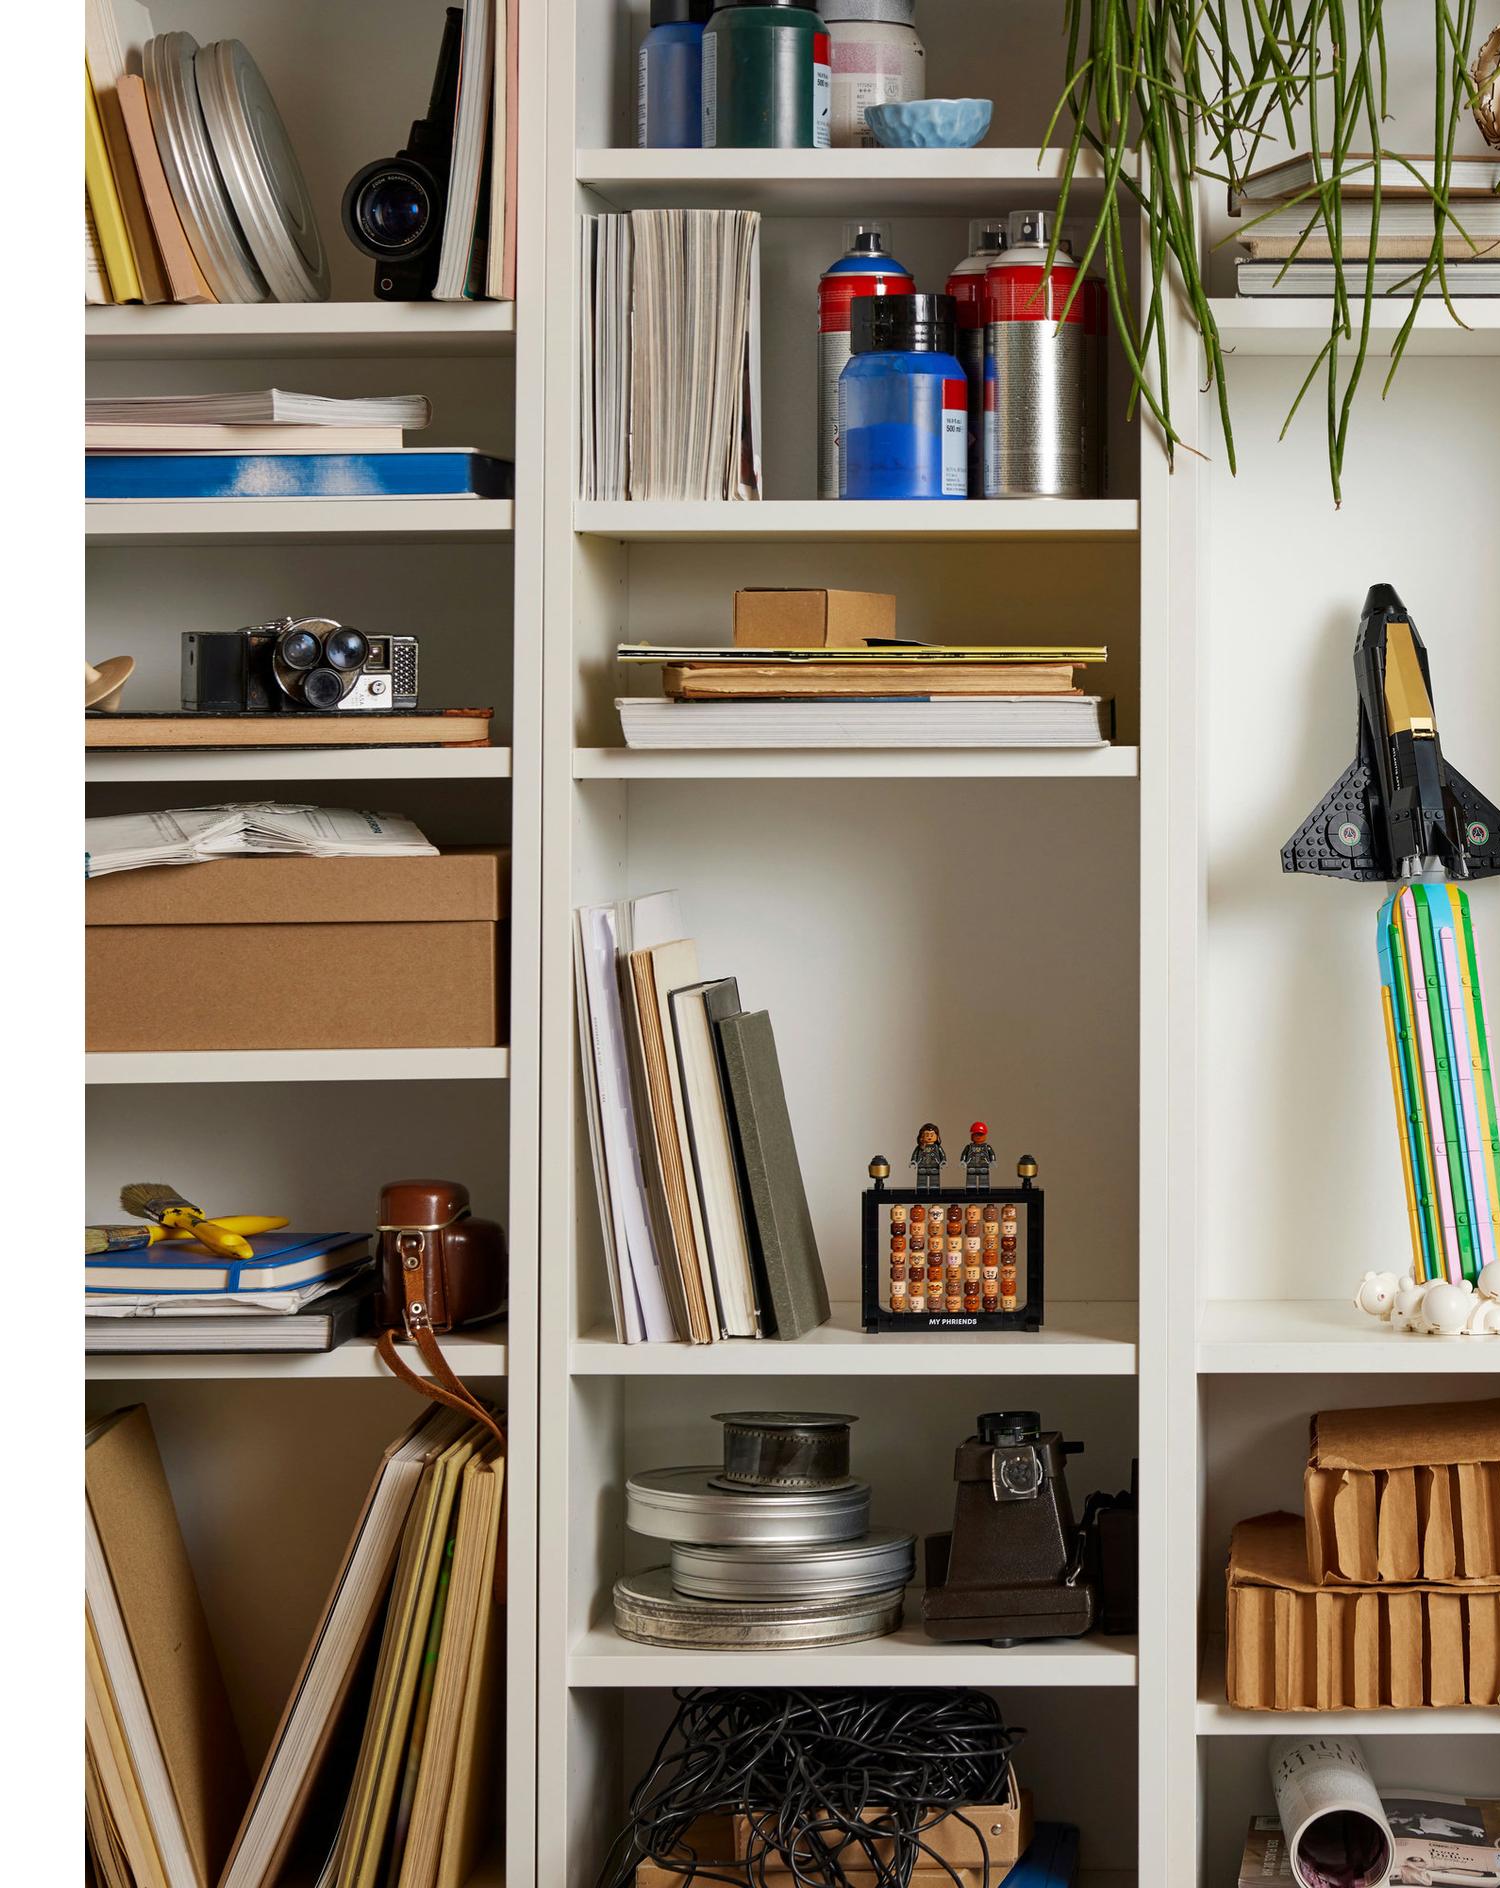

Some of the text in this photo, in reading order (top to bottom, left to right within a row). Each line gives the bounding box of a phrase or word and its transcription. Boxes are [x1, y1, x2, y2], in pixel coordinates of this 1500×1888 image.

[946, 425, 955, 433] 500
[928, 1318, 978, 1326] MY PHRIENDS
